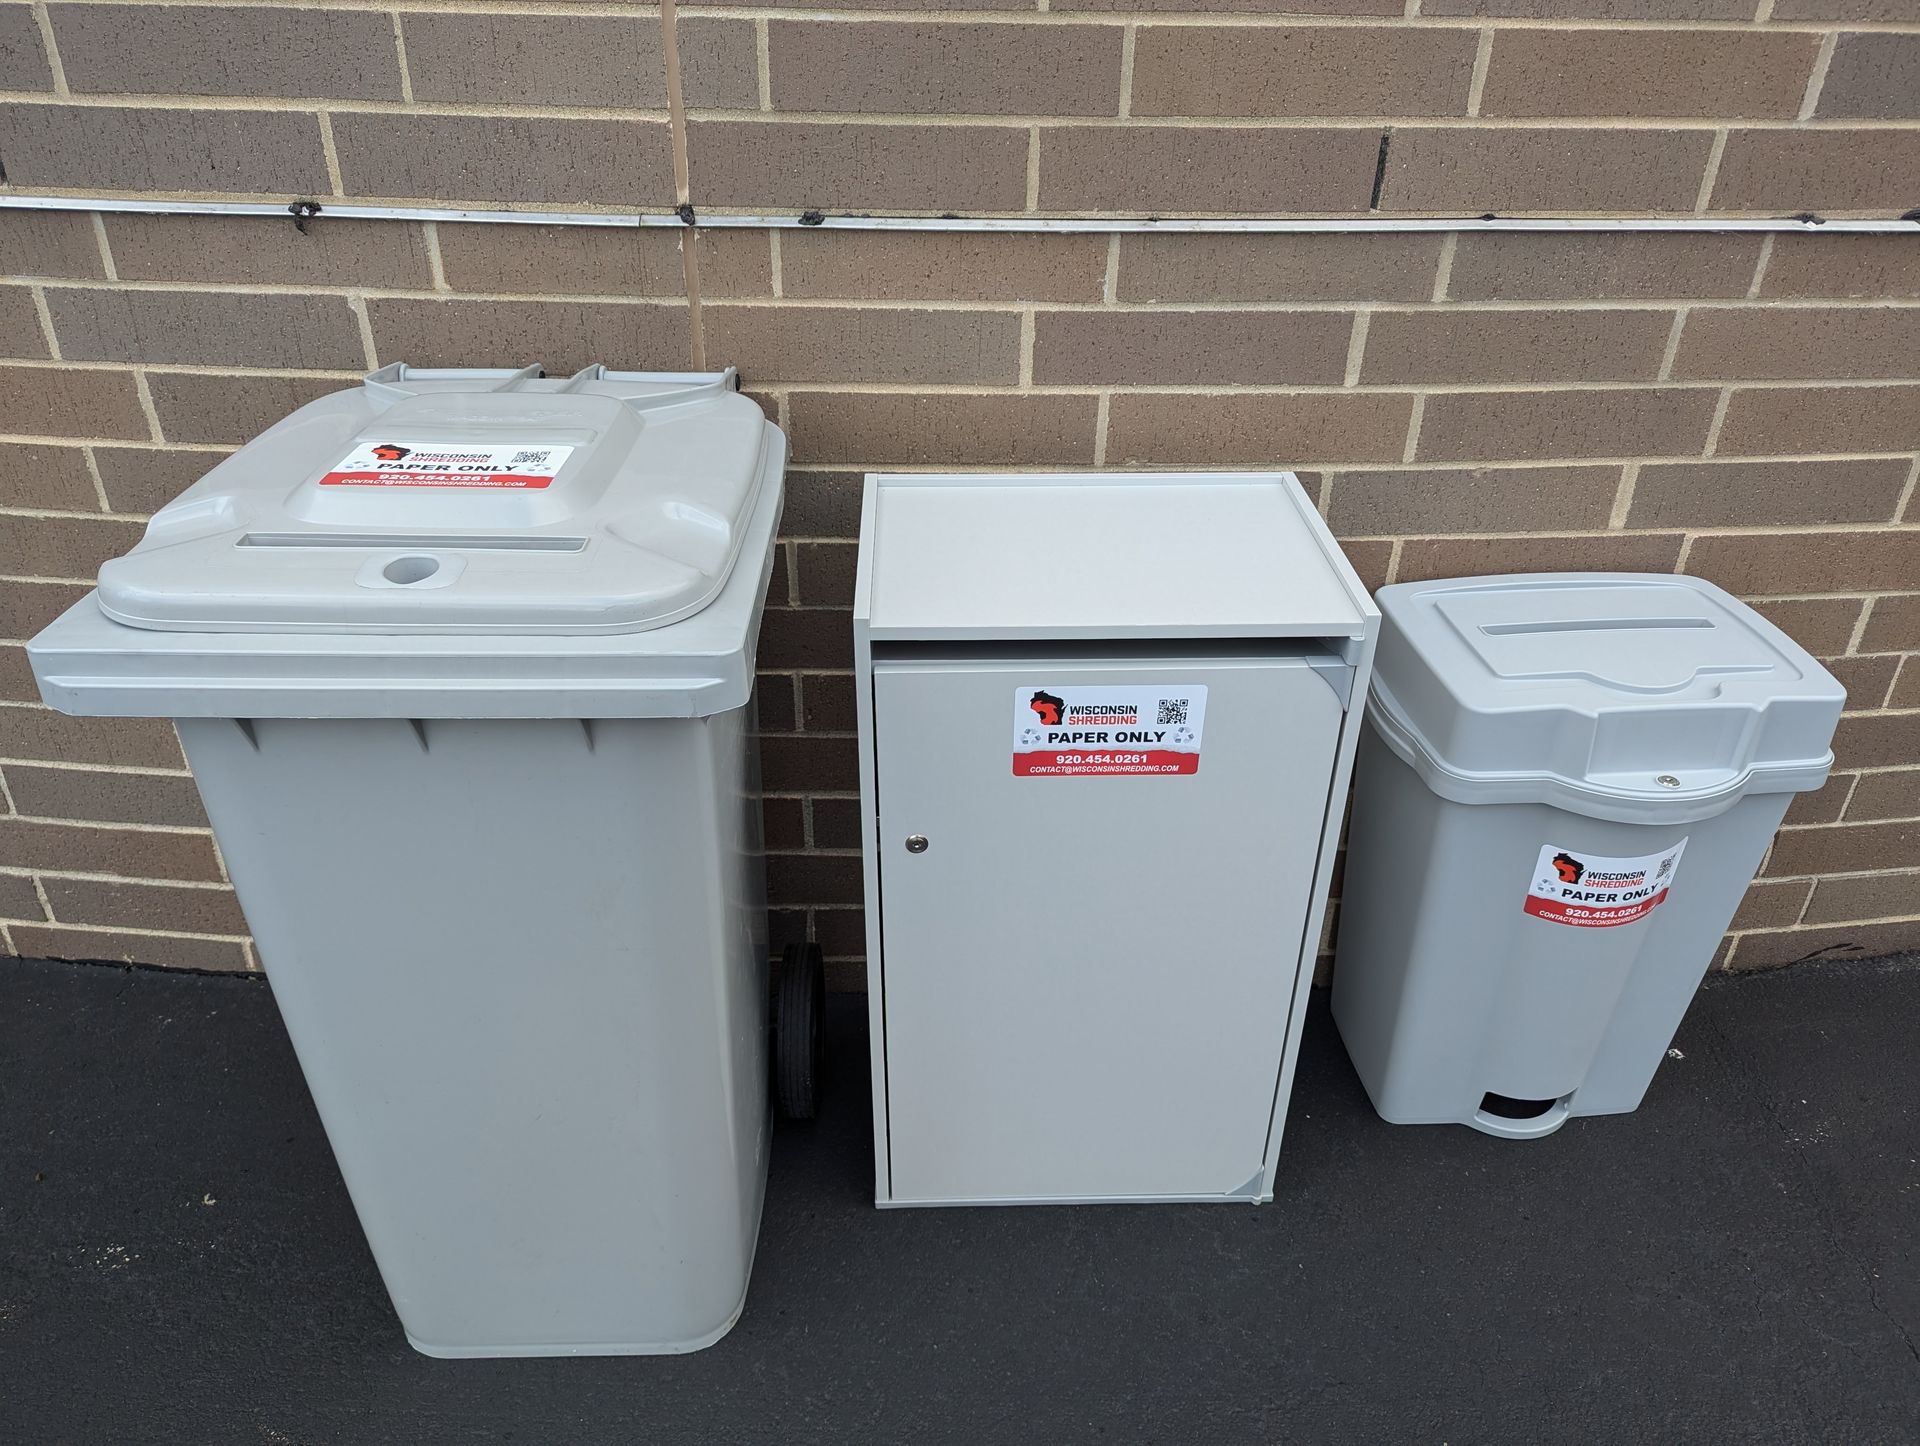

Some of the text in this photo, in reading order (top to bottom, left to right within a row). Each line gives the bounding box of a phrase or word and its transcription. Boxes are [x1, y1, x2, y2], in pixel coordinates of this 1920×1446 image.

[377, 463, 519, 472] PAPER ONLY
[379, 473, 490, 481] 920.454.0261
[341, 479, 527, 487] CONTACT@WISCONSINSHREDDING.COM
[1069, 705, 1138, 715] WISCONSIN
[1068, 715, 1138, 725] SHREDDING
[1047, 731, 1167, 744] PAPER ONLY
[1056, 754, 1148, 764] 920.454.0261
[1029, 764, 1180, 774] CONTACT@WISCONSINSHREDDING.COM
[1587, 870, 1647, 881] WISCONSIN
[1584, 879, 1645, 889] SHREDDING
[1561, 883, 1659, 902] PAPER ONLY
[1565, 905, 1643, 918] 920.454.0261
